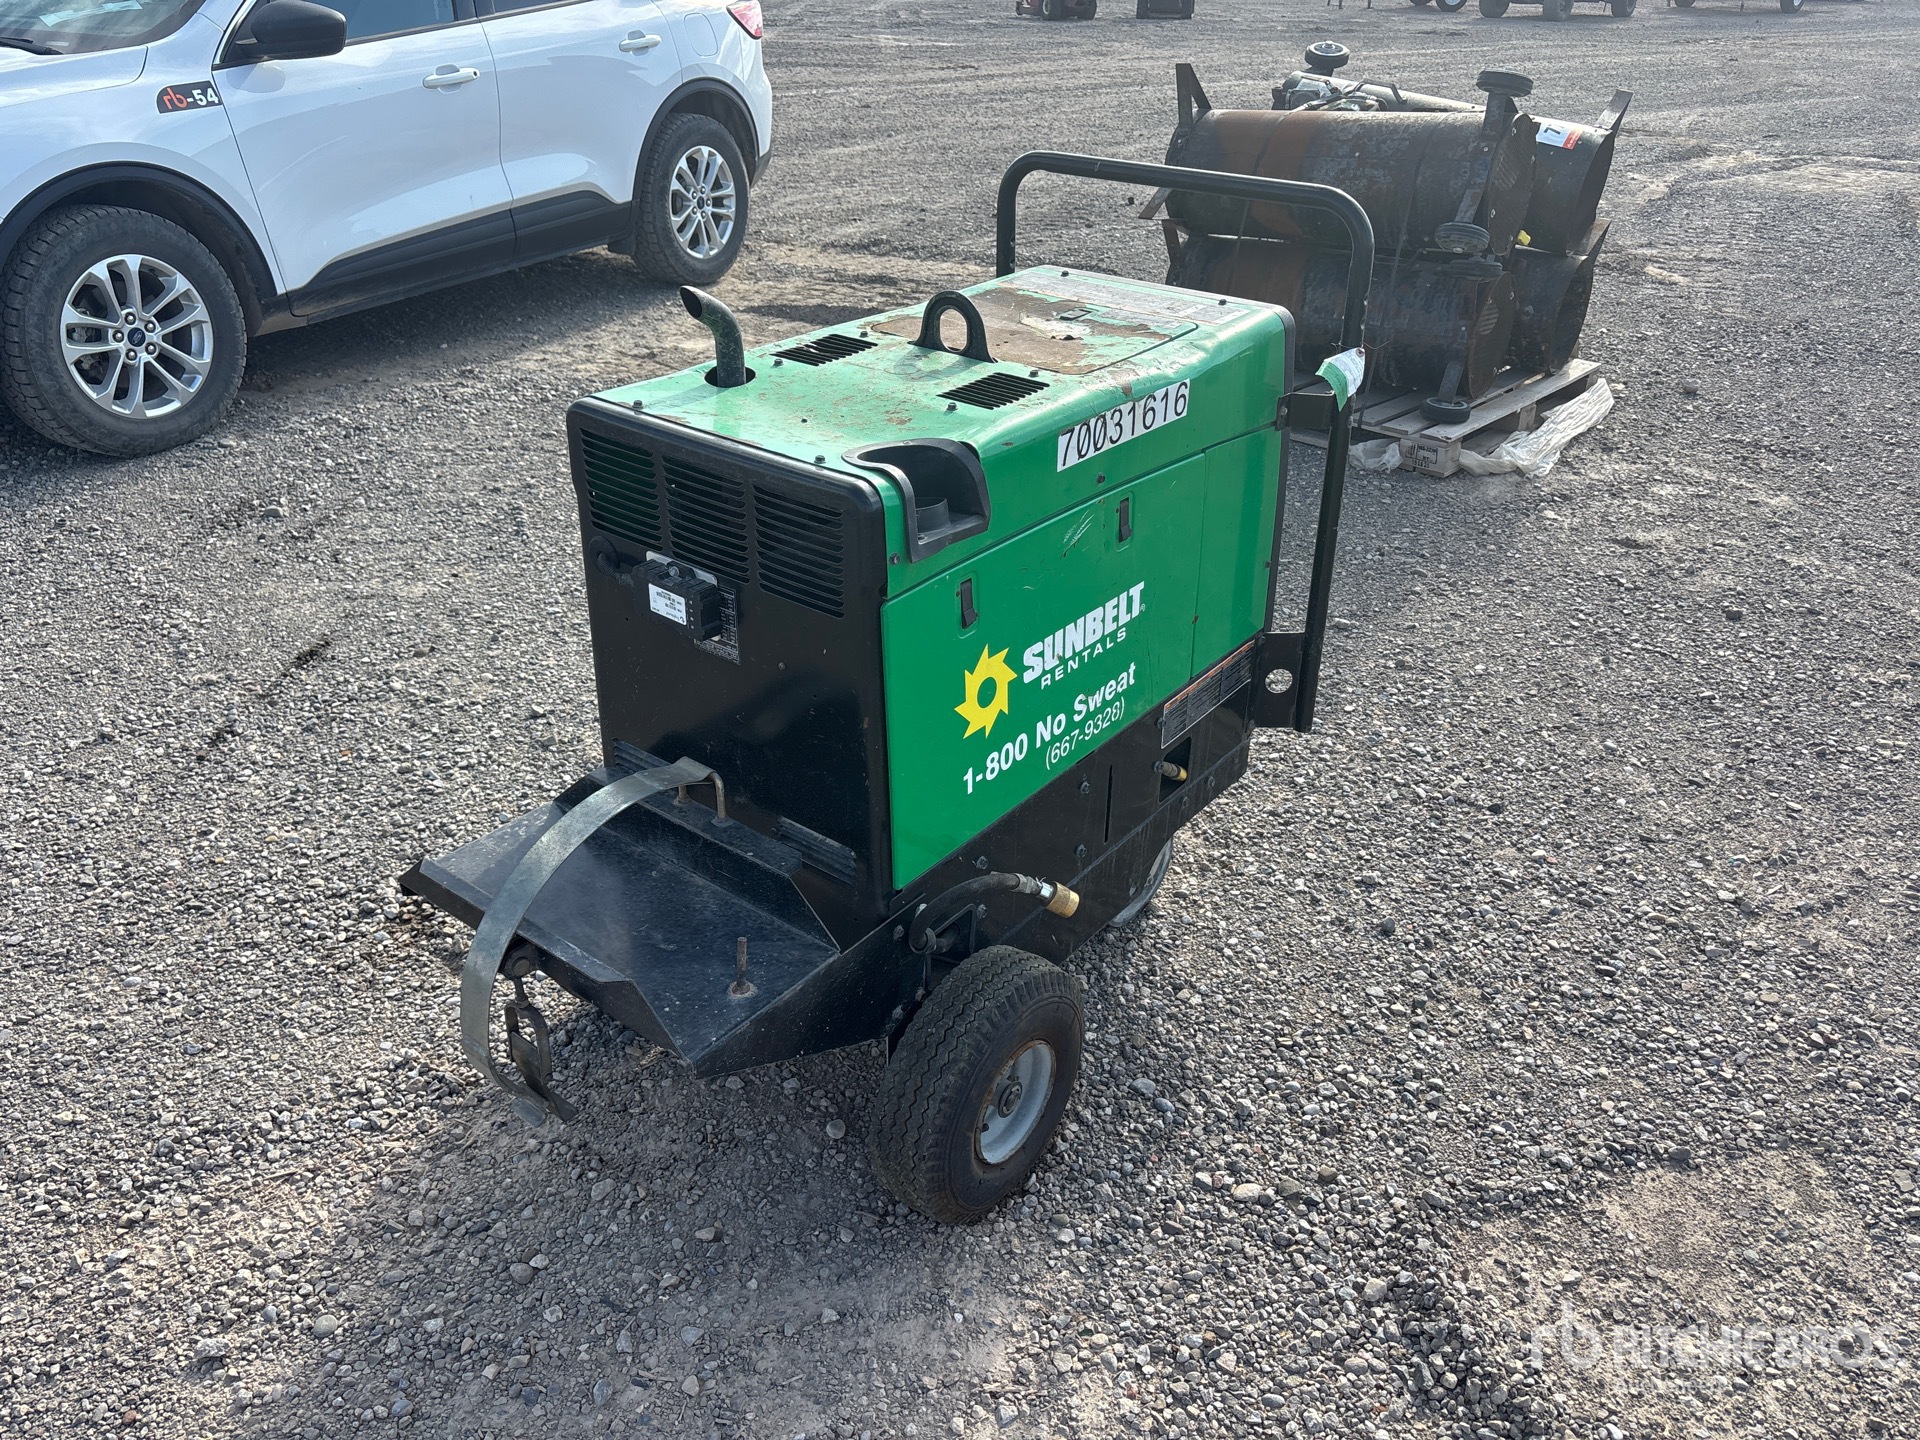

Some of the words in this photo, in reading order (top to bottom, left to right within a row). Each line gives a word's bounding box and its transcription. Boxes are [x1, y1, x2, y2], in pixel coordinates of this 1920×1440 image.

[1060, 381, 1188, 467] 70031616
[1041, 627, 1127, 690] RENTALS
[963, 732, 1028, 795] 1-800
[1036, 713, 1066, 748] No
[1073, 662, 1136, 722] Sweat
[1046, 697, 1126, 770] (667-9328)
